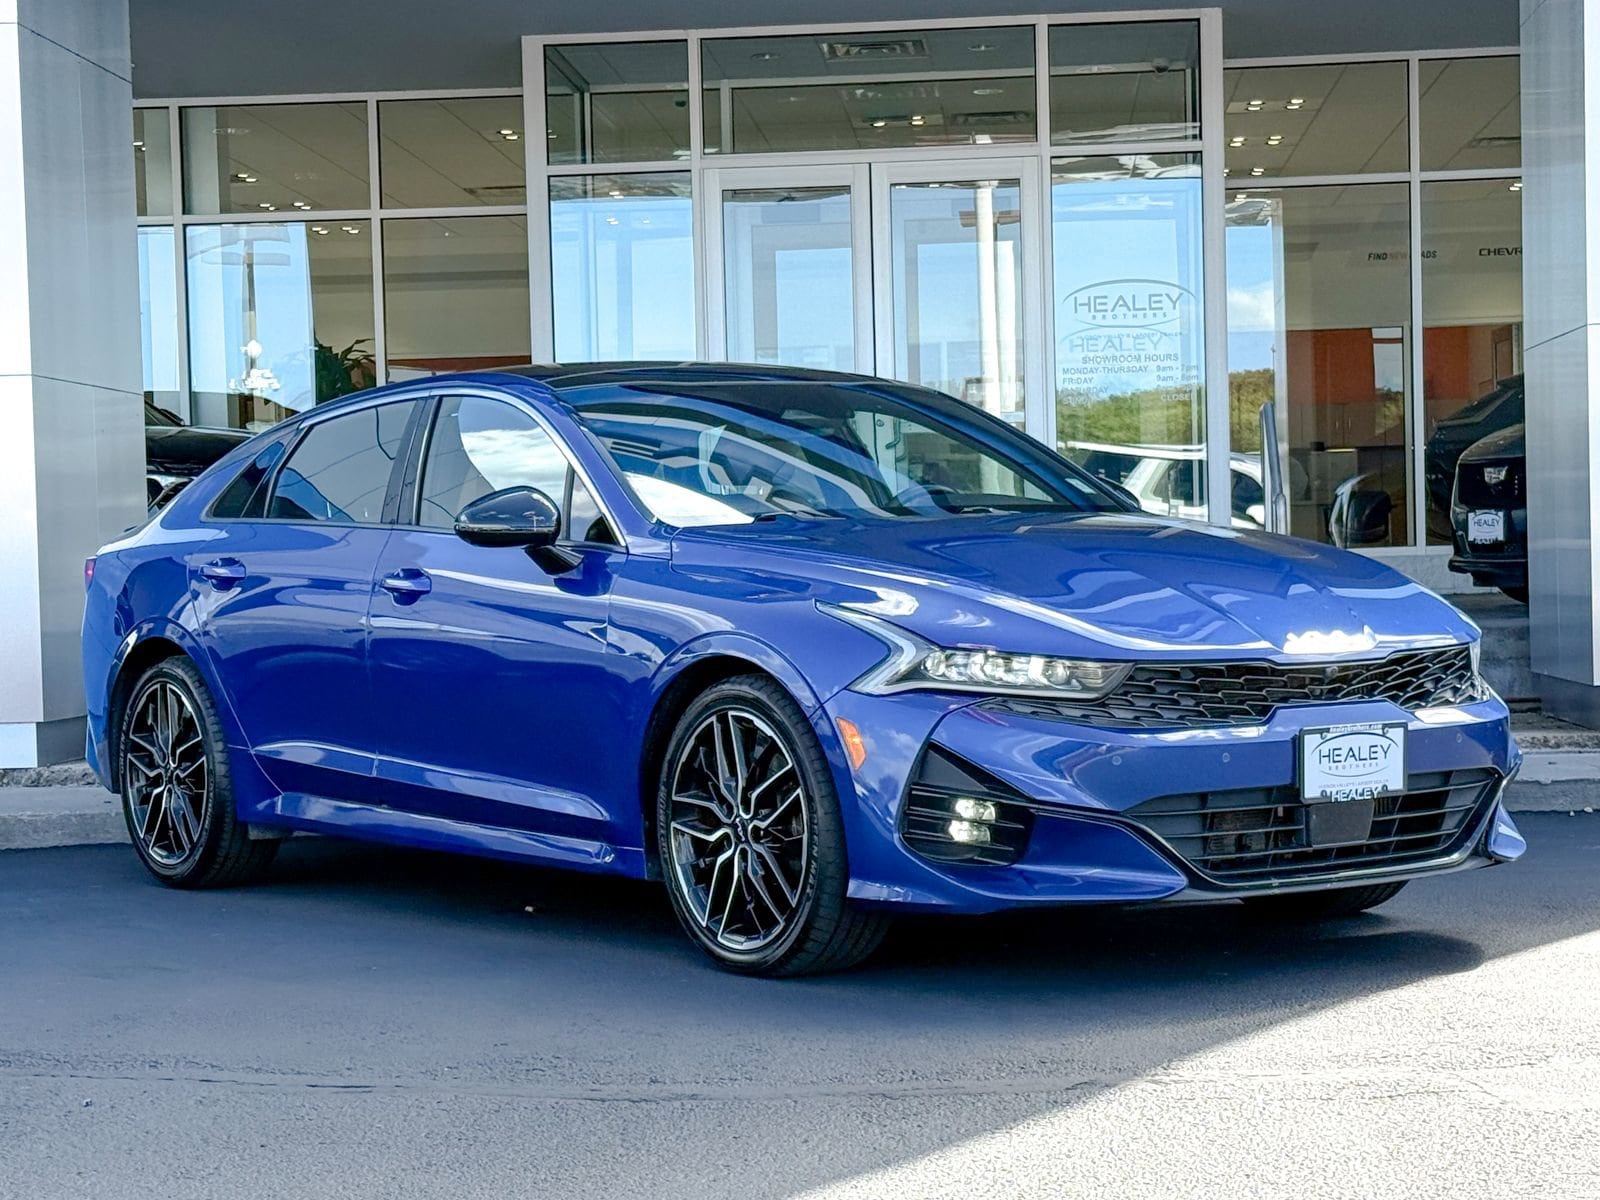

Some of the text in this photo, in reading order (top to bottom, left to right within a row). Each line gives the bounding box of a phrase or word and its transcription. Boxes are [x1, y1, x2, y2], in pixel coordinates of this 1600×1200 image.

[1368, 252, 1388, 261] FIND
[1073, 292, 1184, 314] HEALEY
[1092, 312, 1167, 321] BROTHERS
[1081, 353, 1179, 365] SHOWROOM HOURS
[1062, 365, 1149, 375] MONDAY-THURSDAY
[1160, 393, 1193, 402] CLOSE
[1473, 518, 1500, 527] HEALEY
[1319, 743, 1391, 765] HEALEY
[1328, 761, 1379, 771] BROTHERS
[1331, 786, 1379, 803] HEALEY
